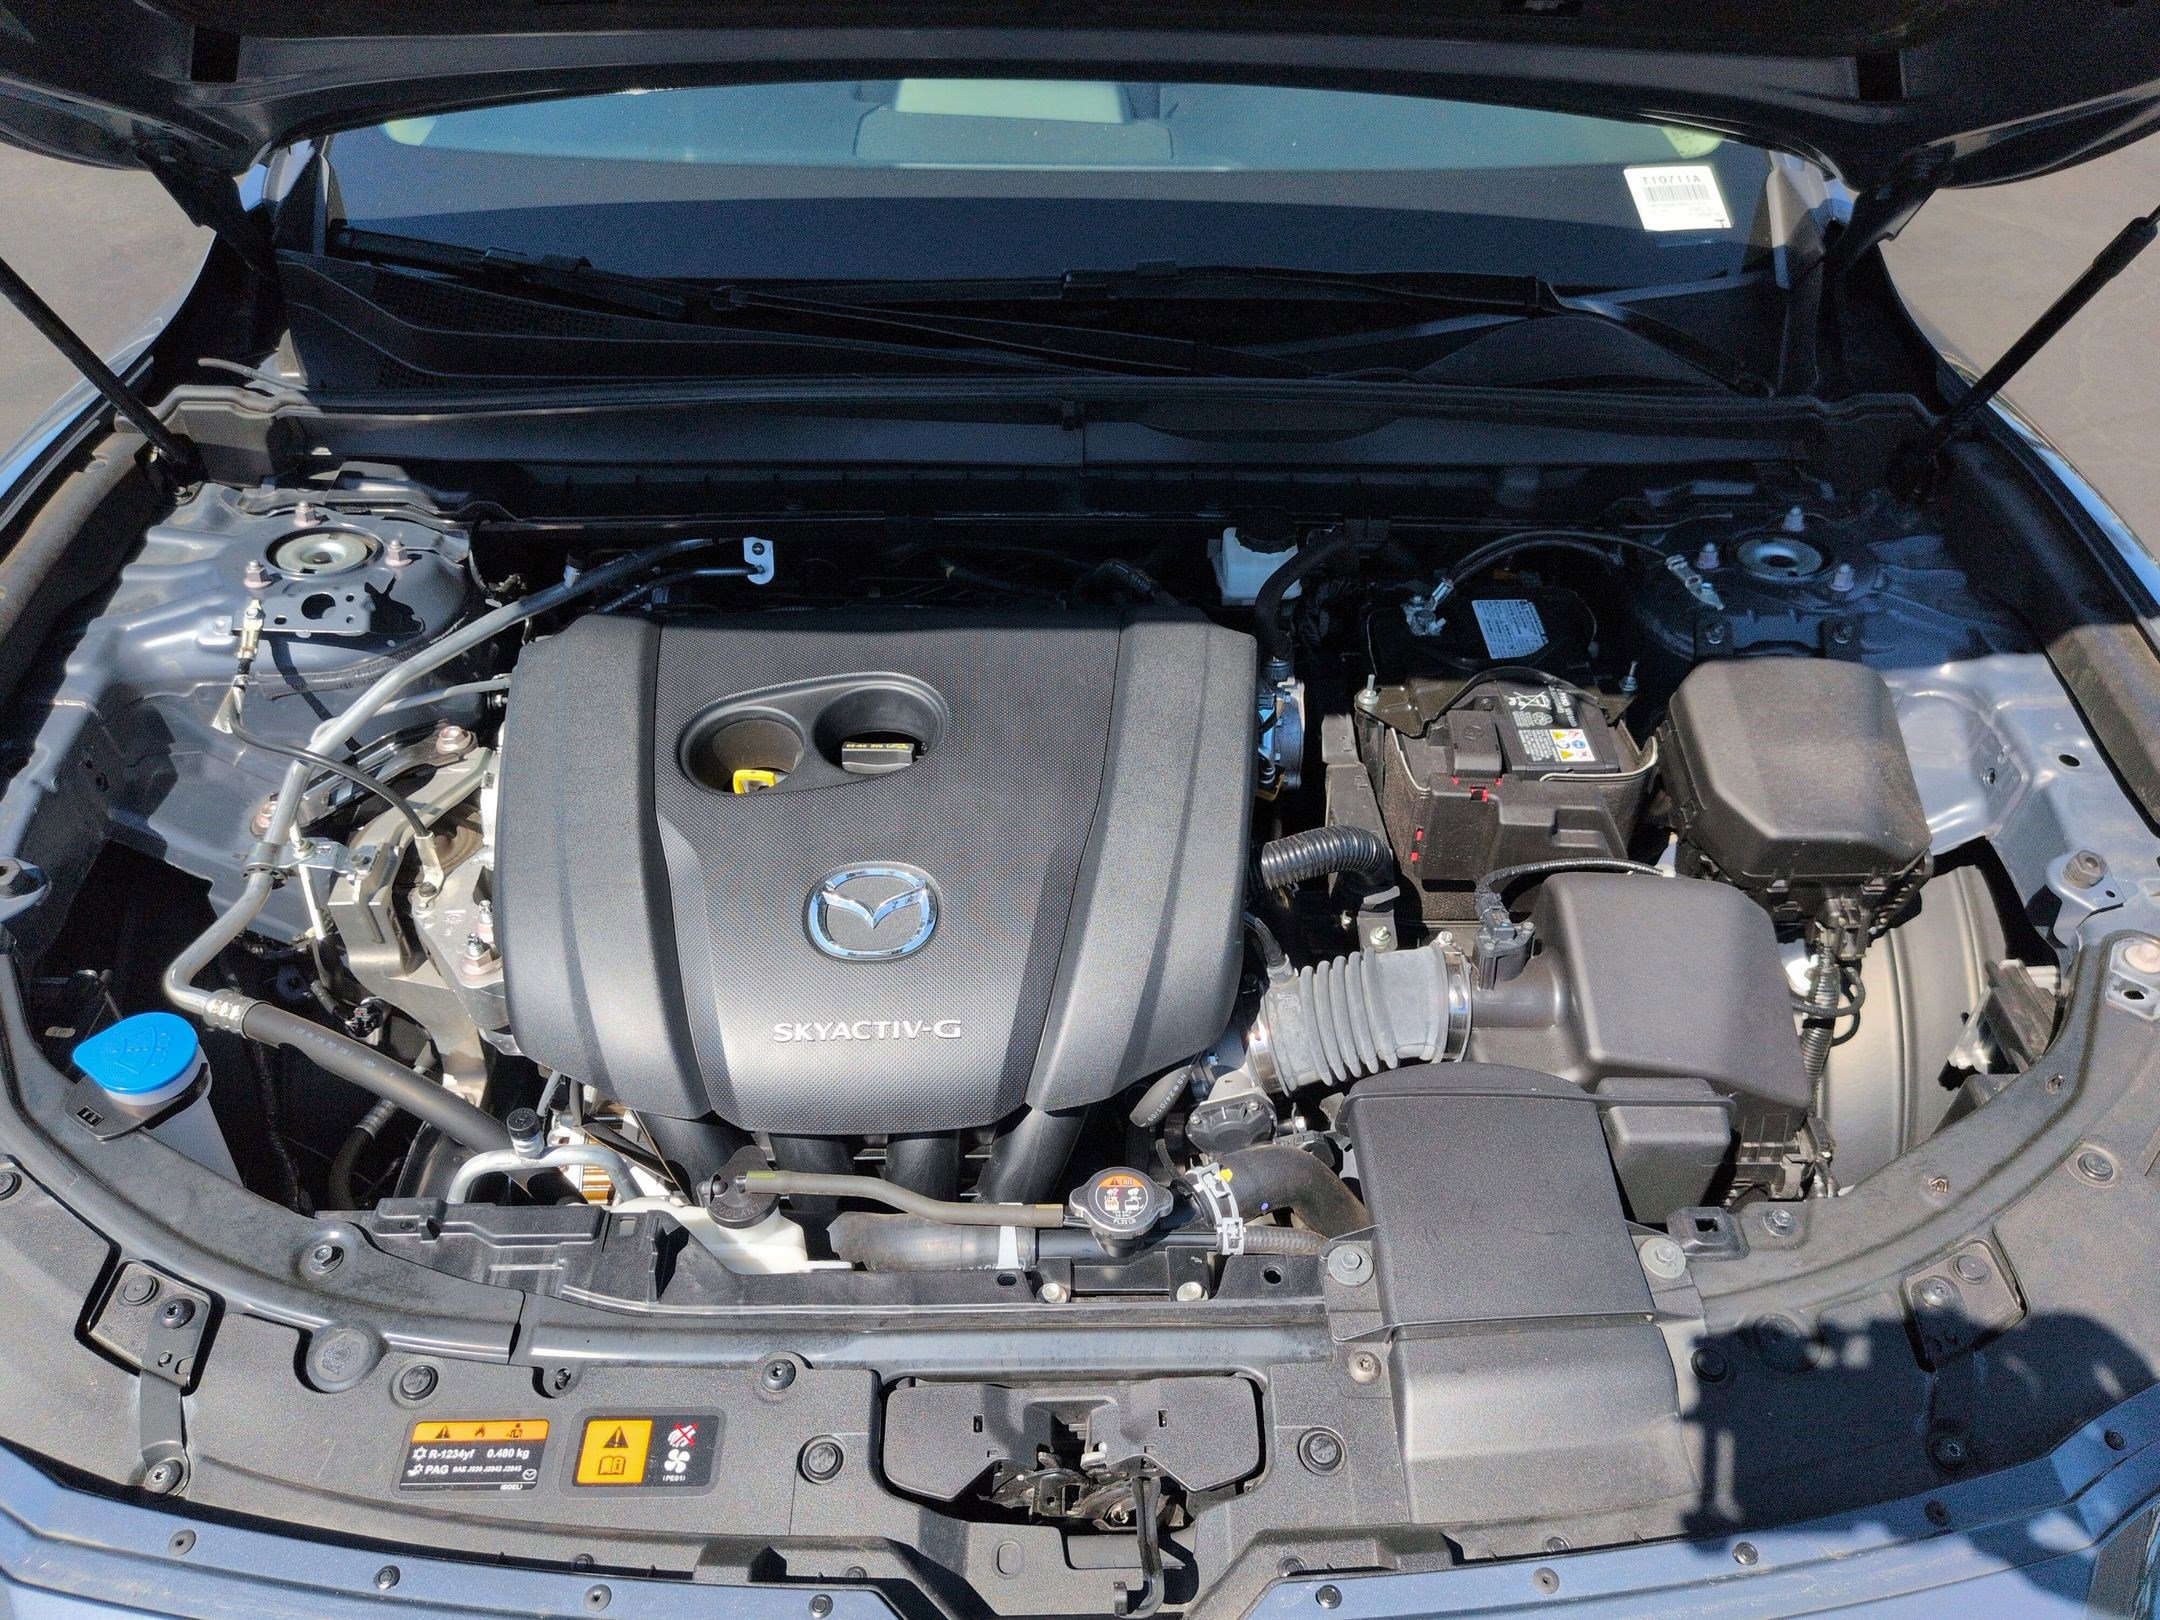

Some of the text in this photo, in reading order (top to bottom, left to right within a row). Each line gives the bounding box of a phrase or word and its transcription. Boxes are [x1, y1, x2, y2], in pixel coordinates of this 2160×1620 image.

[773, 1019, 962, 1042] SKYACTIV-G
[428, 1448, 530, 1461] R-1234yf 0.480 kg
[424, 1465, 449, 1475] PAG
